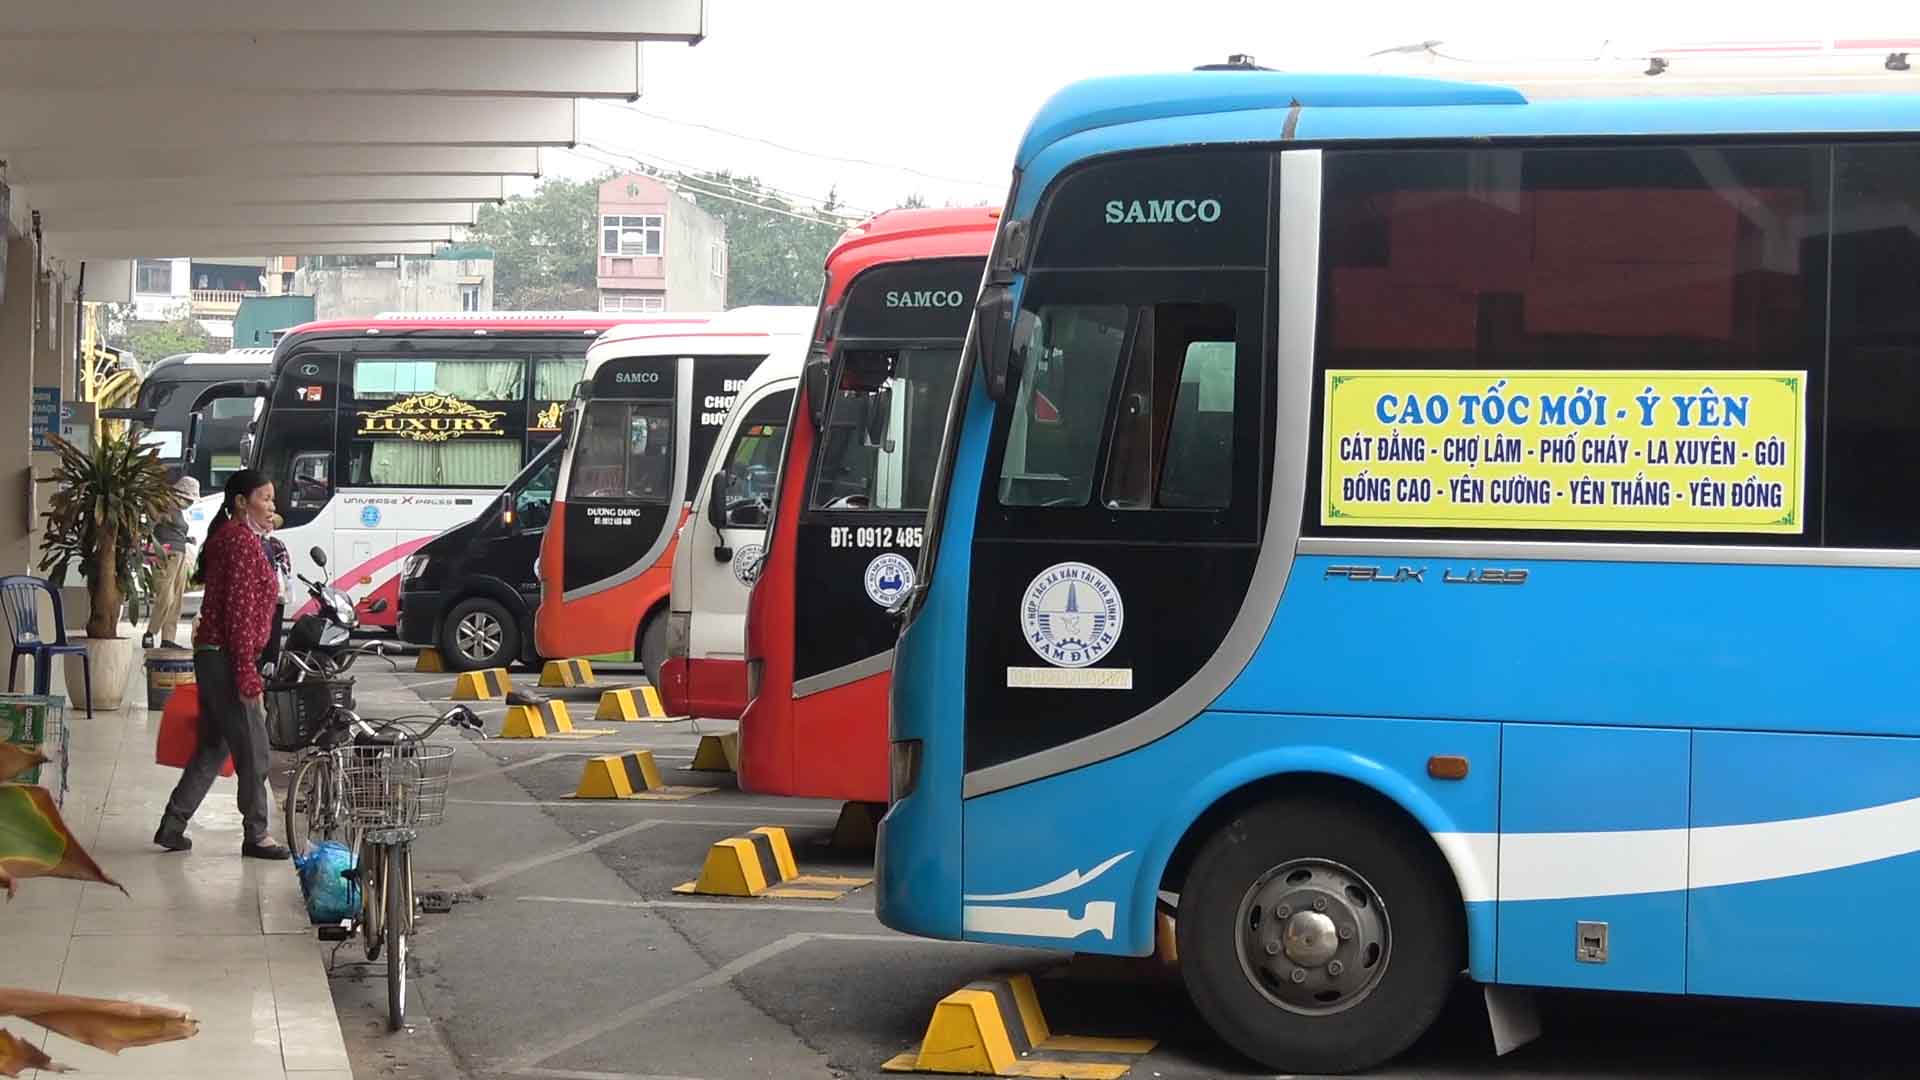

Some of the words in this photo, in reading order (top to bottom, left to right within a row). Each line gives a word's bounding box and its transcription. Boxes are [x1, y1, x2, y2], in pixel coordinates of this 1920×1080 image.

[1105, 199, 1221, 223] SAMCO
[886, 291, 963, 308] SAMCO
[615, 372, 659, 383] SAMCO
[1376, 394, 1449, 425] CAO
[1459, 380, 1530, 426] TỐC
[1539, 387, 1607, 426] MỚI
[1635, 387, 1661, 426] Ý
[1672, 386, 1749, 427] YÊN
[365, 417, 498, 431] LUXURY
[1340, 433, 1373, 462] CÁT
[1443, 435, 1480, 468] CHỢ
[1484, 433, 1522, 463] LÂM
[1540, 431, 1578, 464] PHỐ
[1582, 434, 1629, 464] CHÁY
[1647, 439, 1669, 465] LA
[1674, 435, 1736, 466] XUYÊN
[1755, 436, 1785, 466] GÔI
[1396, 478, 1431, 503] CAO
[1450, 474, 1484, 503] YÊN
[1490, 474, 1551, 504] CƯỜNG
[1569, 475, 1605, 505] YÊN
[1611, 472, 1670, 506] THẮNG
[1689, 477, 1725, 507] YÊN
[1731, 475, 1782, 508] ĐỒNG
[831, 526, 853, 548] ĐT:
[857, 527, 893, 548] 0912
[896, 527, 923, 548] 485
[1031, 631, 1065, 661] NAM
